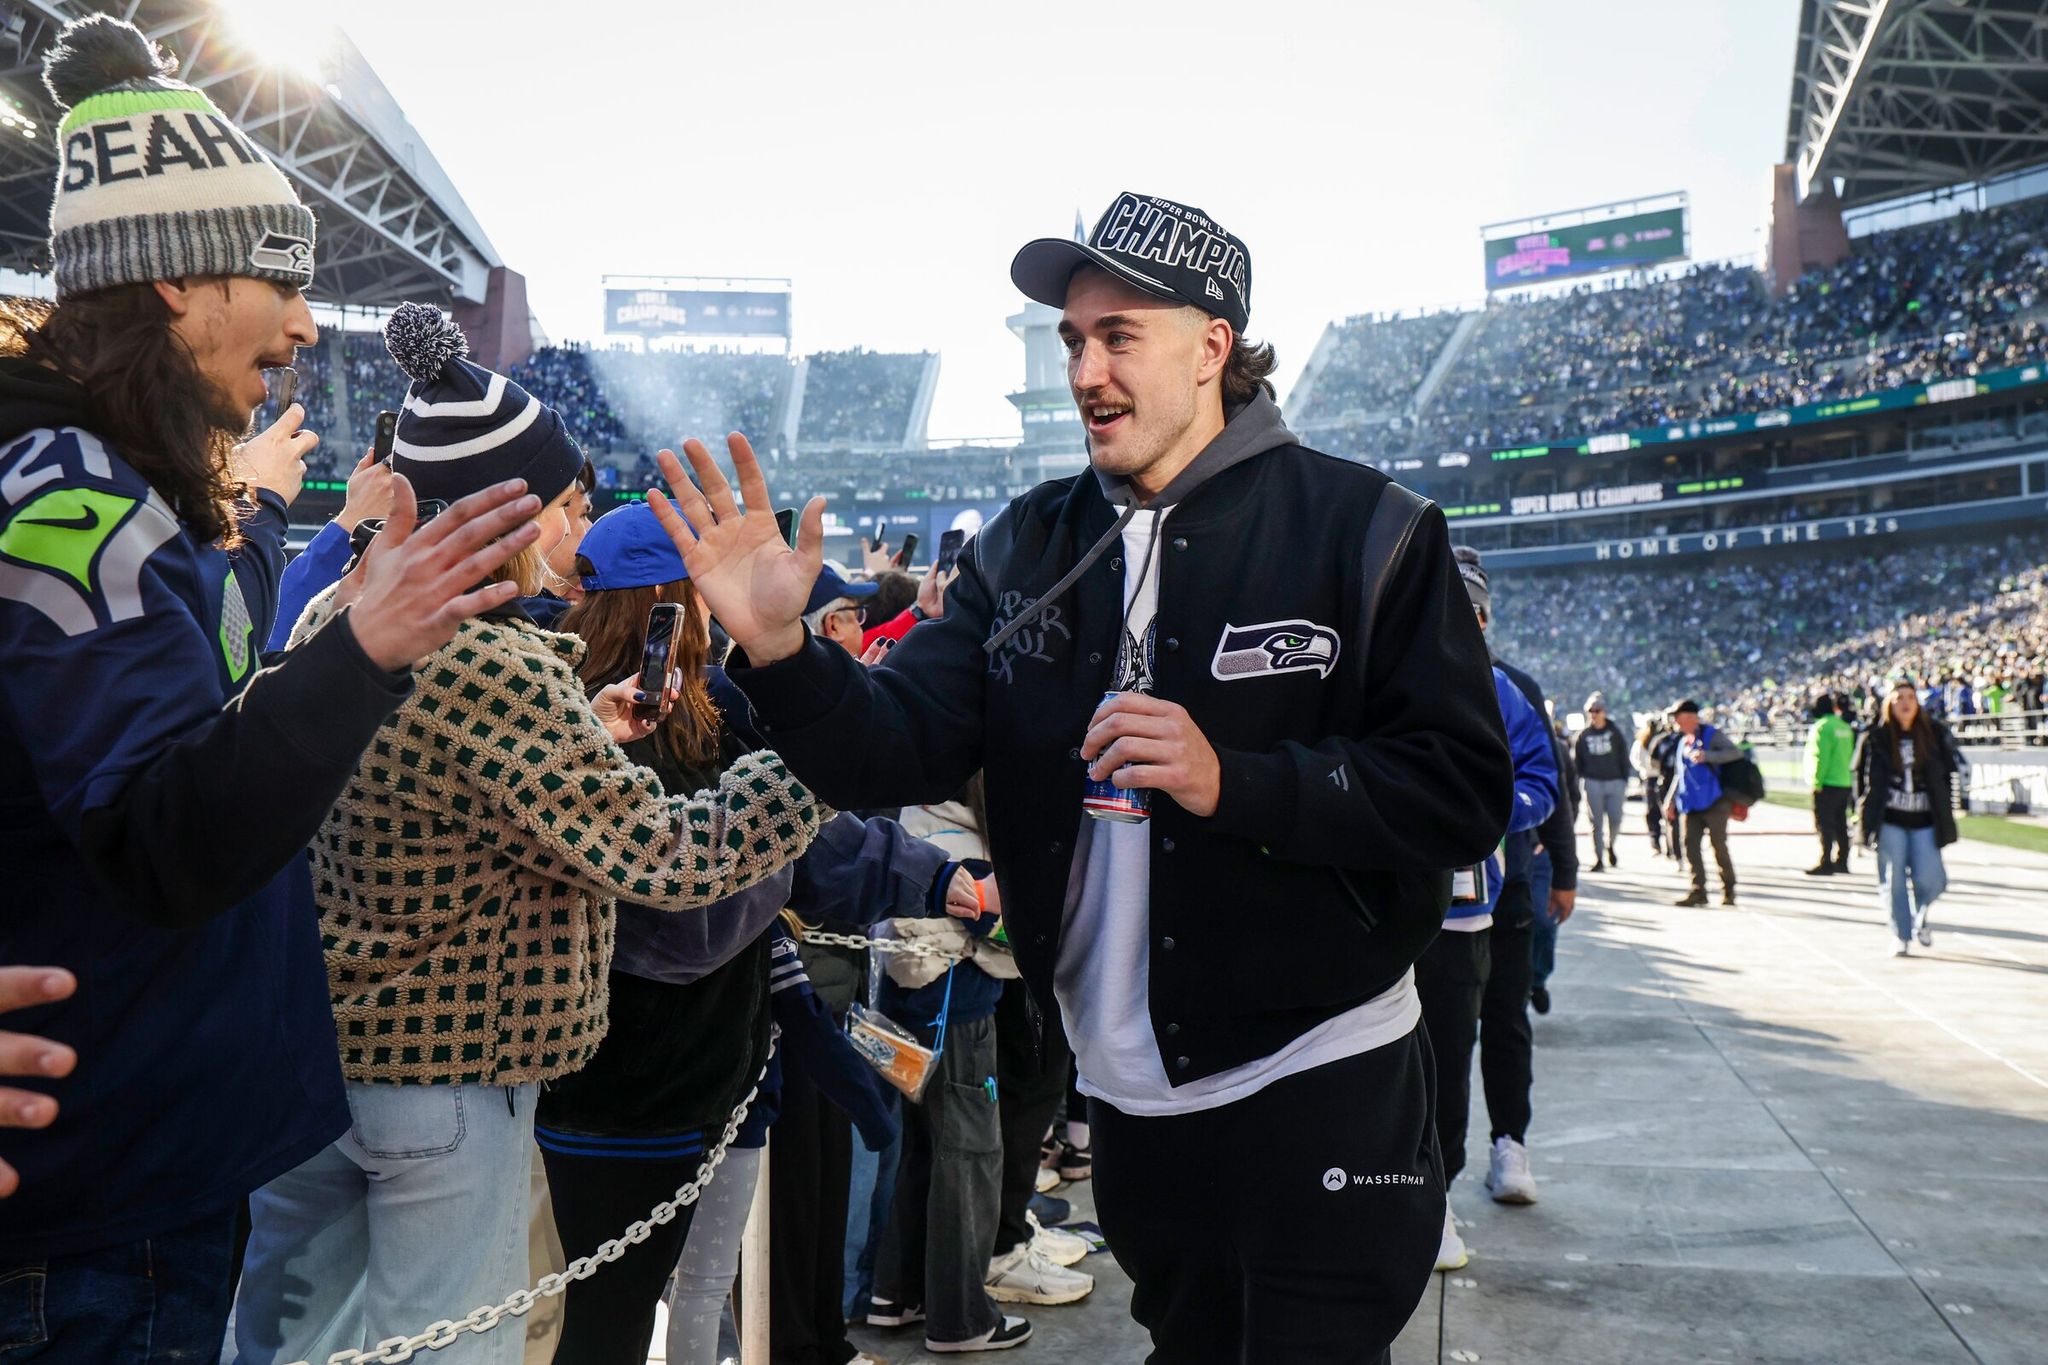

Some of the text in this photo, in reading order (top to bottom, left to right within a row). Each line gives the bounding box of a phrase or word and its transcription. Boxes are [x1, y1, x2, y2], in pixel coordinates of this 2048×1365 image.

[1150, 197, 1228, 238] SUPER BOWL LX
[1097, 193, 1247, 302] CHAMPIO
[0, 426, 113, 506] 21
[1596, 517, 1898, 560] HOME OF THE 12s
[1353, 1174, 1424, 1186] WASSERMAN
